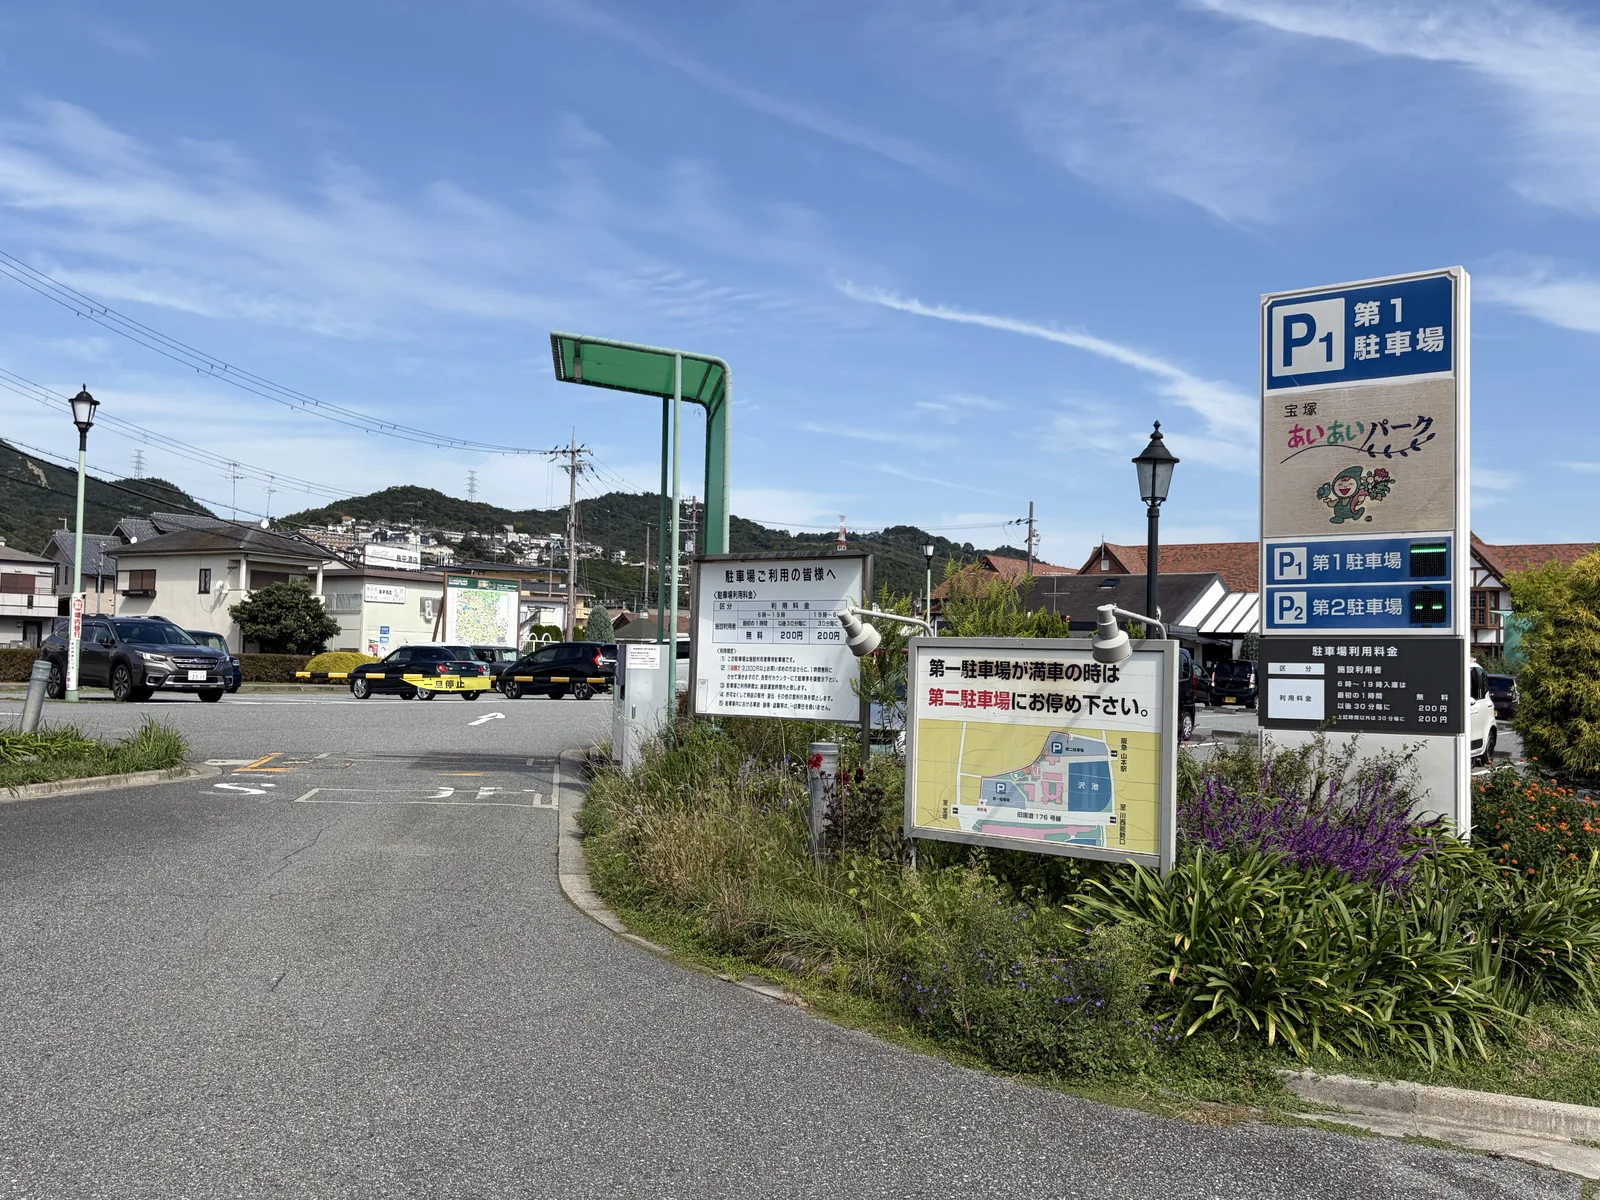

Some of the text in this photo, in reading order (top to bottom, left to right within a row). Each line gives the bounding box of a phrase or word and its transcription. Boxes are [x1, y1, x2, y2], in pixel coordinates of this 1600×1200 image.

[1353, 298, 1403, 328] 第1
[1353, 326, 1445, 361] 駐車場
[1284, 402, 1317, 417] 宝塚
[1287, 415, 1434, 453] あいあいパーク
[1312, 552, 1402, 571] 第1駐車場
[725, 568, 837, 583] 駐車場ご利用の皆様へ
[771, 602, 810, 610] 利用料金
[1312, 598, 1403, 616] 第2駐車場
[745, 631, 841, 641] 無料 200円 200円
[1312, 646, 1398, 657] 駐車場利用料金
[929, 659, 1120, 683] 第一駐車場が満車の時は
[1337, 666, 1382, 674] 施設利用者
[424, 680, 465, 688] 一旦停止
[928, 688, 1148, 717] 第二駐車場にお停め下さい。
[1279, 694, 1312, 702] 利用料金
[1416, 693, 1449, 701] 無料
[1418, 704, 1448, 713] 200円
[1418, 715, 1448, 724] 200円
[1077, 781, 1099, 791] 沢池
